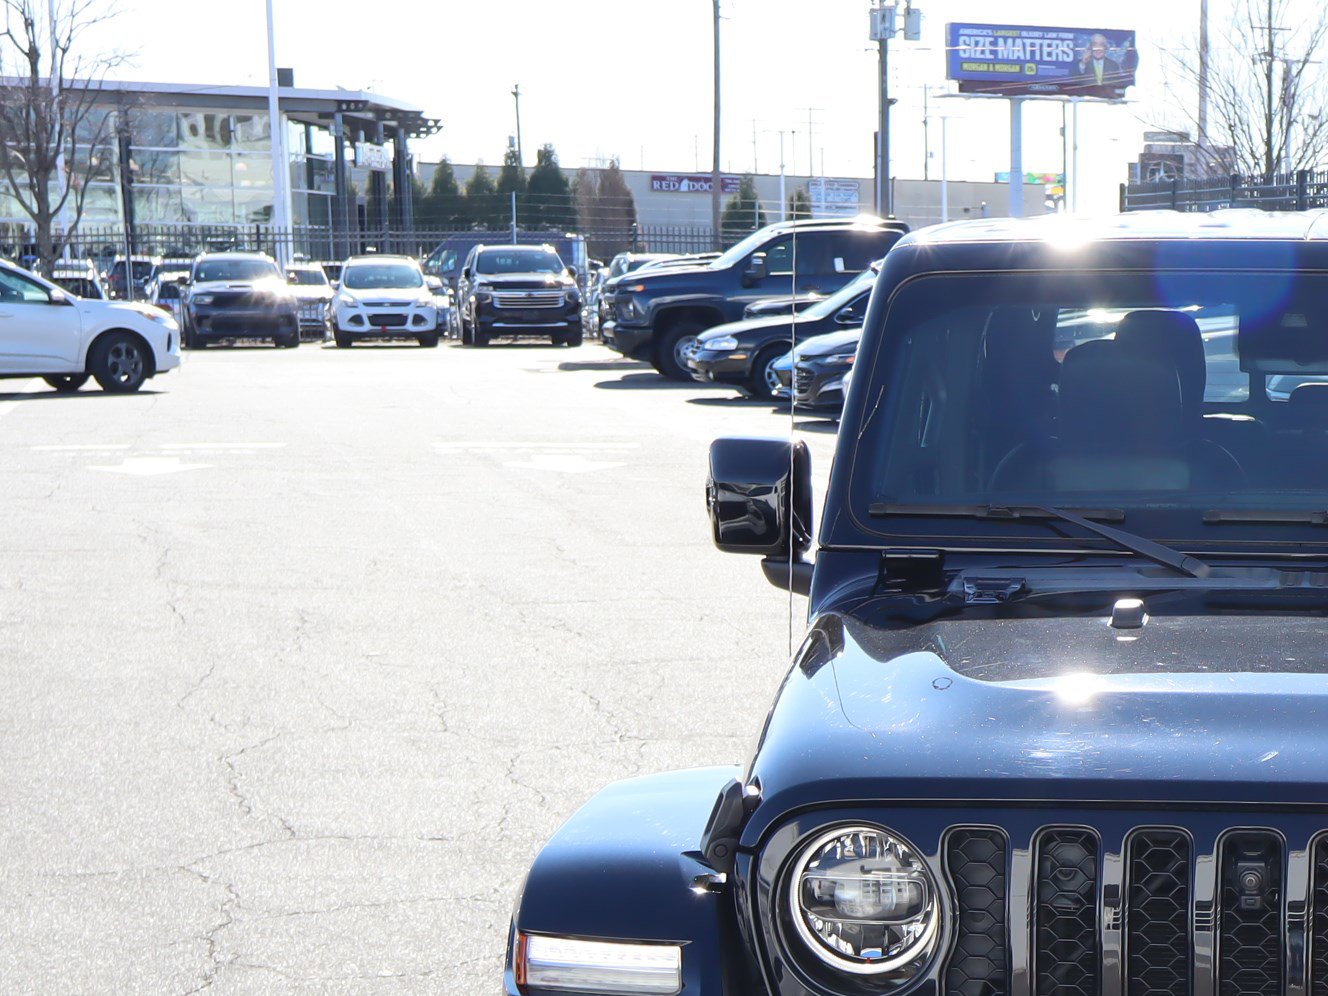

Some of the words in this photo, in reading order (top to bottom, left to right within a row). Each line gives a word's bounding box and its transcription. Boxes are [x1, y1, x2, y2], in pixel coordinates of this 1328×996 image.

[959, 36, 994, 59] SIZE
[998, 38, 1074, 62] MATTERS
[653, 180, 679, 190] RED
[689, 181, 714, 192] DOO
